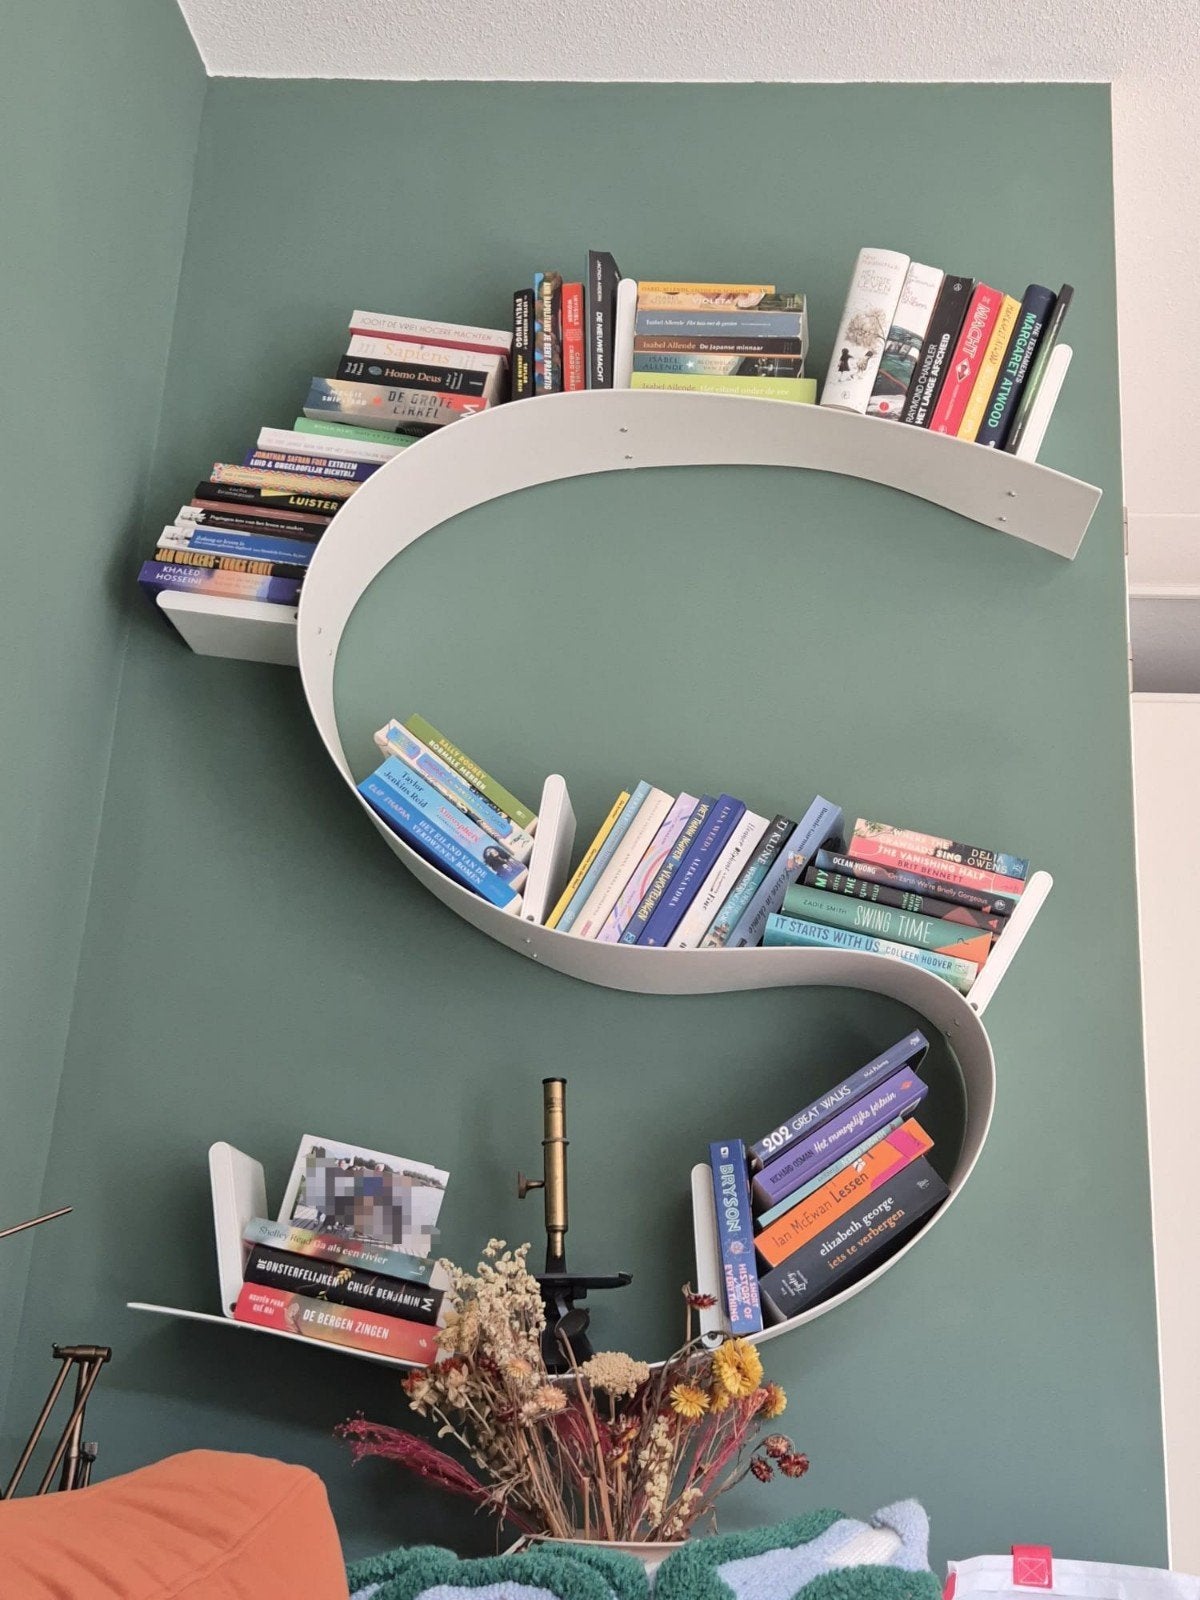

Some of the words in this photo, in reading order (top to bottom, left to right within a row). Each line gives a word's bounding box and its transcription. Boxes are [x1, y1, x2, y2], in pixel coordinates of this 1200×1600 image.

[388, 320, 397, 329] DE
[597, 312, 603, 322] DE
[1033, 323, 1042, 336] THE
[962, 304, 990, 360] MACHT
[1007, 312, 1036, 376] MARGARET
[384, 344, 451, 367] Sapiens
[644, 363, 683, 371] ALLENDE
[1016, 338, 1036, 384] TESTAMENTS
[385, 368, 415, 380] Homo
[418, 373, 442, 384] Deus
[642, 382, 665, 390] Isabel
[667, 383, 696, 391] Allende
[907, 385, 924, 423] RAYMOND
[919, 343, 937, 384] CHANDLER
[916, 407, 927, 425] HET
[922, 377, 937, 406] LANGE
[932, 333, 951, 376] AFSCHEID
[389, 391, 404, 403] DE
[988, 378, 1013, 429] ATWOOD
[328, 460, 357, 471] EXTREEM
[289, 496, 339, 511] LUISTER
[156, 573, 202, 586] HOSSEINI
[163, 565, 200, 577] KHALED
[428, 740, 459, 767] NORMALE
[459, 767, 487, 791] MENSEN
[438, 739, 461, 759] SALLY
[458, 756, 488, 781] ROONEY
[369, 784, 385, 798] ELIF
[384, 769, 409, 795] Jenkins
[411, 791, 428, 809] Reid
[402, 771, 424, 792] Taylor
[695, 803, 709, 820] VIET
[717, 806, 731, 824] LISA
[811, 807, 829, 830] Bonnie
[777, 819, 789, 832] TJ
[419, 820, 436, 835] HET
[434, 833, 463, 858] EILAND
[461, 855, 477, 869] VAN
[475, 867, 488, 879] DE
[701, 824, 720, 853] WEEDA
[756, 833, 782, 865] KLUNE
[412, 825, 457, 863] VERDWENEN
[455, 861, 483, 885] BOMEN
[833, 858, 854, 869] OCEAN
[854, 863, 877, 875] VUONG
[879, 846, 897, 857] THE
[899, 852, 956, 873] VANISHING
[959, 868, 986, 882] HALF
[936, 850, 963, 864] SING
[966, 857, 1008, 875] OWENS
[971, 849, 1004, 865] DELIA
[668, 858, 701, 909] ALEKSANDRA
[769, 868, 792, 897] Lessen
[815, 870, 829, 889] MY
[898, 861, 918, 871] BRIT
[922, 867, 964, 883] BENNETT
[845, 878, 856, 894] THE
[899, 876, 916, 885] Earth
[918, 881, 936, 890] We're
[937, 886, 957, 897] Briefly
[958, 892, 988, 906] Gorgeous
[765, 895, 774, 905] in
[804, 899, 825, 909] ZADIE
[827, 905, 847, 915] SMITH
[775, 918, 786, 929] IT
[789, 921, 830, 940] STARTS
[833, 932, 864, 949] WITH
[865, 940, 881, 953] US
[854, 905, 893, 933] SWING
[896, 915, 934, 943] TIME
[885, 947, 920, 962] COLLEEN
[922, 956, 953, 970] HOOVER
[762, 1126, 793, 1152] 202
[791, 1107, 821, 1131] GREAT
[820, 1086, 852, 1111] WALKS
[813, 1138, 830, 1153] Het
[827, 1110, 872, 1144] onmogelijke
[869, 1091, 899, 1115] fortuin
[769, 1164, 795, 1184] RICHARD
[793, 1150, 815, 1168] OSMAN
[720, 1164, 741, 1232] BRYSON
[830, 1170, 870, 1202] Lessen
[259, 1226, 289, 1241] Shelley
[291, 1234, 312, 1246] Read
[774, 1231, 792, 1247] Ian
[791, 1200, 834, 1233] McEwan
[818, 1220, 863, 1256] elizabeth
[861, 1197, 897, 1227] george
[827, 1251, 847, 1269] iets
[846, 1244, 858, 1255] te
[856, 1208, 908, 1249] verbergen
[313, 1240, 326, 1249] Ga
[328, 1244, 342, 1253] als
[343, 1249, 359, 1258] een
[361, 1252, 388, 1265] rivier
[257, 1257, 268, 1270] DE
[266, 1259, 340, 1290] ONSTERFELIJKEN
[739, 1264, 750, 1305] HISTORY
[376, 1288, 420, 1308] BENJAMIN
[725, 1265, 739, 1322] EVERYTHING
[750, 1282, 759, 1307] SHORT
[303, 1310, 317, 1322] DE
[318, 1313, 353, 1331] BERGEN
[355, 1322, 389, 1340] ZINGEN
[744, 1308, 752, 1319] OF
